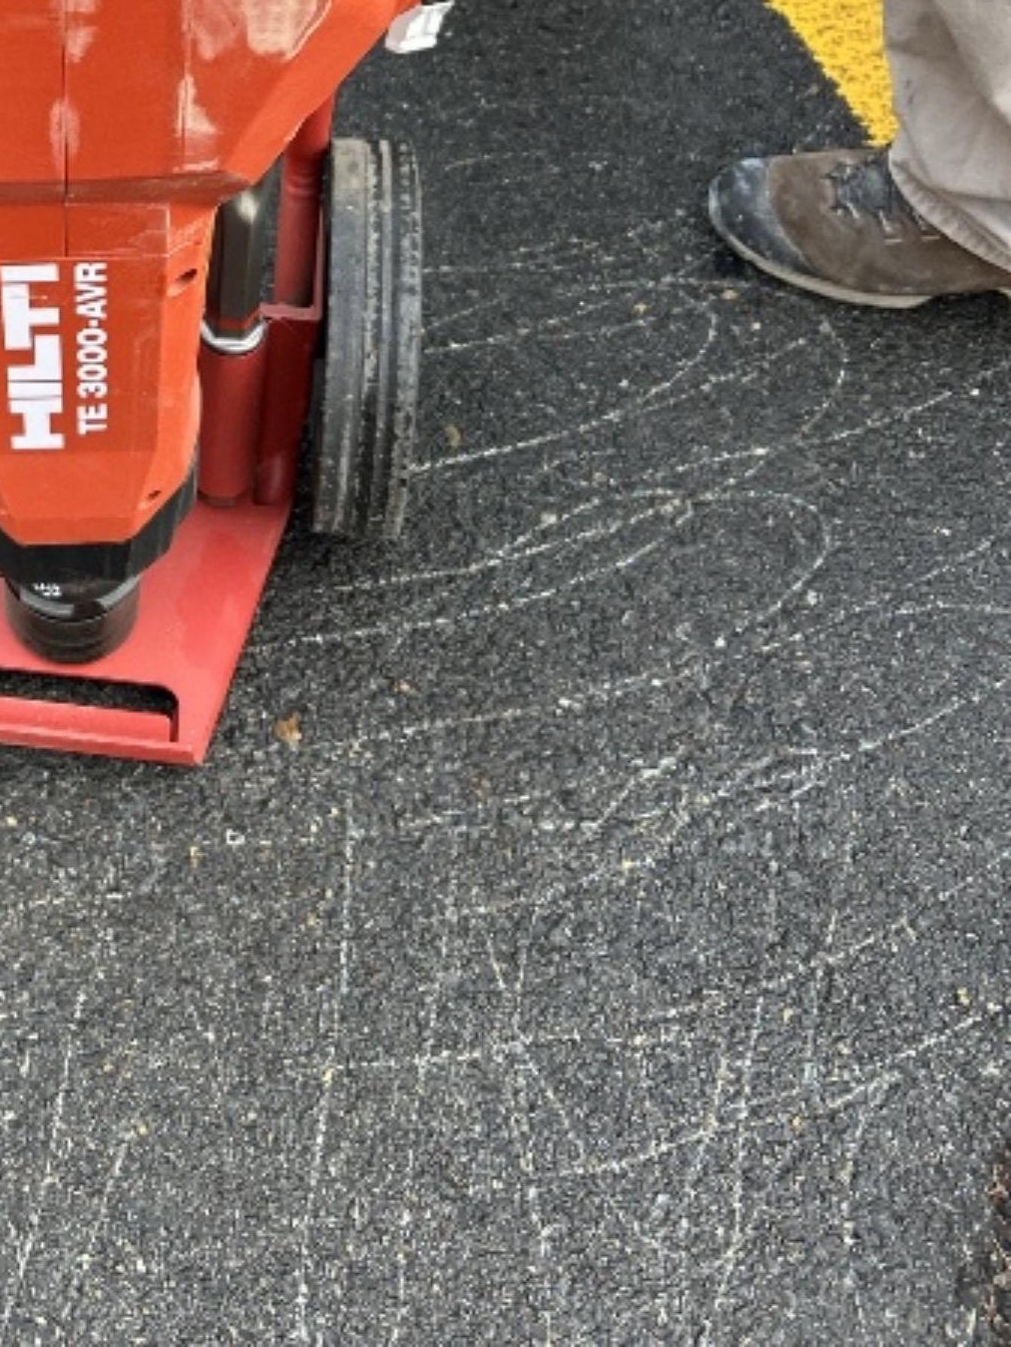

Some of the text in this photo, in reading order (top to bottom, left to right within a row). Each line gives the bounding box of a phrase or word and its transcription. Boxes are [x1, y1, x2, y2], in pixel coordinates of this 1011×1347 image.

[0, 263, 65, 449] HILTI
[73, 262, 108, 436] TE 3000-AVR
